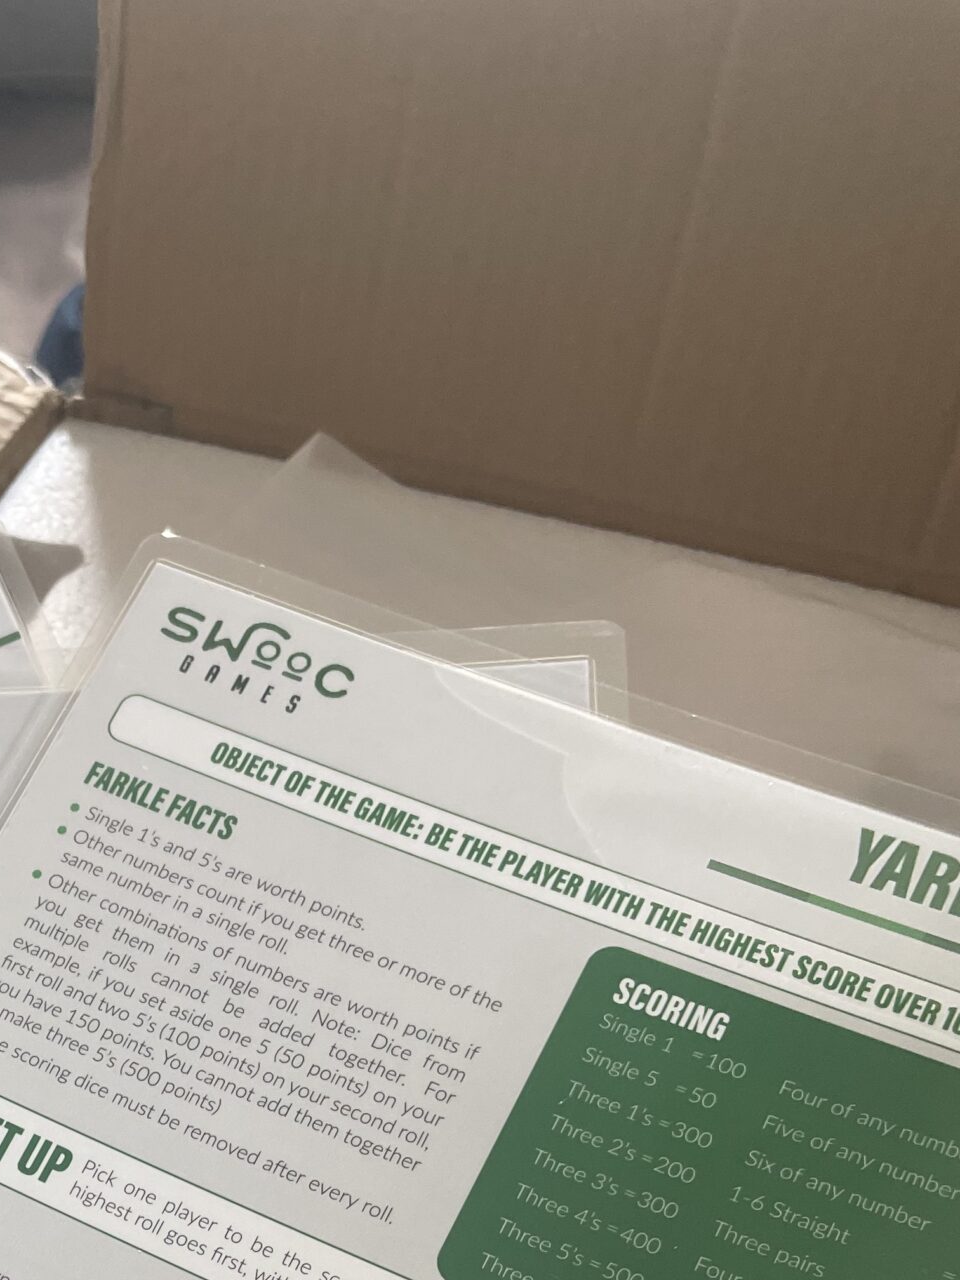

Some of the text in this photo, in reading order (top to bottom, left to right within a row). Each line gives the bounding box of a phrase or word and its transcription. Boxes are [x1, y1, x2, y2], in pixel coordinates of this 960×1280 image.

[179, 654, 302, 715] GAMES
[83, 761, 239, 840] FARKLE FACTS
[84, 806, 365, 931] Single 1's and 5's are worth points.
[210, 742, 942, 1026] OBJECT OF THE GAME: BE THE PLAYER WITH THE HIGHEST SCORE OVER
[849, 827, 960, 915] YAR
[598, 1013, 656, 1046] Single
[661, 1037, 674, 1054] 1
[612, 977, 730, 1041] SCORING
[17, 1133, 74, 1183] UP
[69, 1180, 133, 1222] highest
[134, 1215, 165, 1236] roll
[163, 1229, 208, 1256] goes
[210, 1246, 247, 1278] first,
[729, 1186, 851, 1245] 1-6 Straight
[714, 1219, 825, 1278] Three pairs
